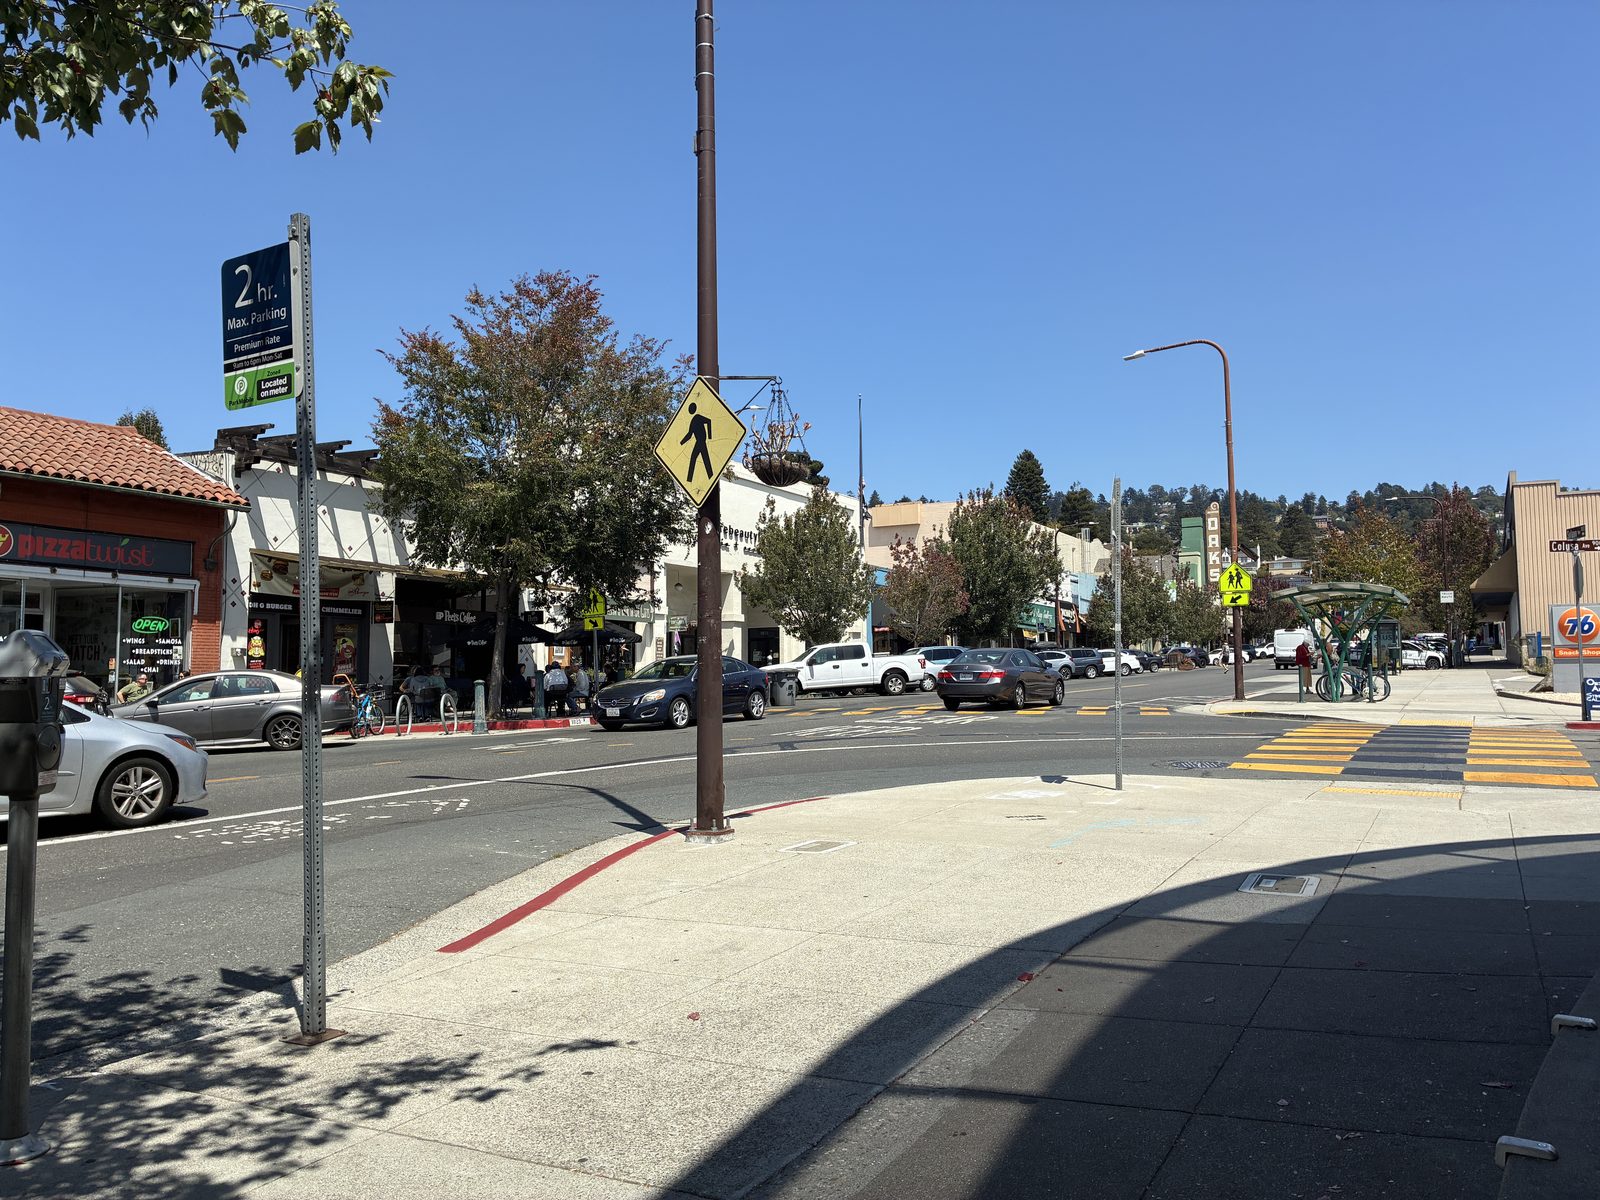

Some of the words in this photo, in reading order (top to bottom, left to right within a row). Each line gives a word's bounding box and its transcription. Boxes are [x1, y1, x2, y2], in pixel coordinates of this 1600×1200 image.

[234, 264, 254, 308] 2
[257, 282, 278, 302] hr.
[227, 317, 249, 331] Max.
[251, 307, 287, 324] Parking
[234, 339, 264, 353] Premium
[265, 335, 281, 345] Rate
[232, 360, 244, 370] 9am
[250, 357, 261, 366] 6pm
[262, 352, 283, 363] Mon-Sat
[261, 376, 287, 389] Located
[260, 389, 269, 398] on
[269, 386, 288, 396] meter
[1208, 518, 1220, 582] OAKS
[1551, 541, 1579, 551] Colusa
[134, 619, 165, 631] OPEN
[460, 611, 476, 624] Coffee
[1565, 614, 1595, 636] 76
[1581, 649, 1600, 657] Shop
